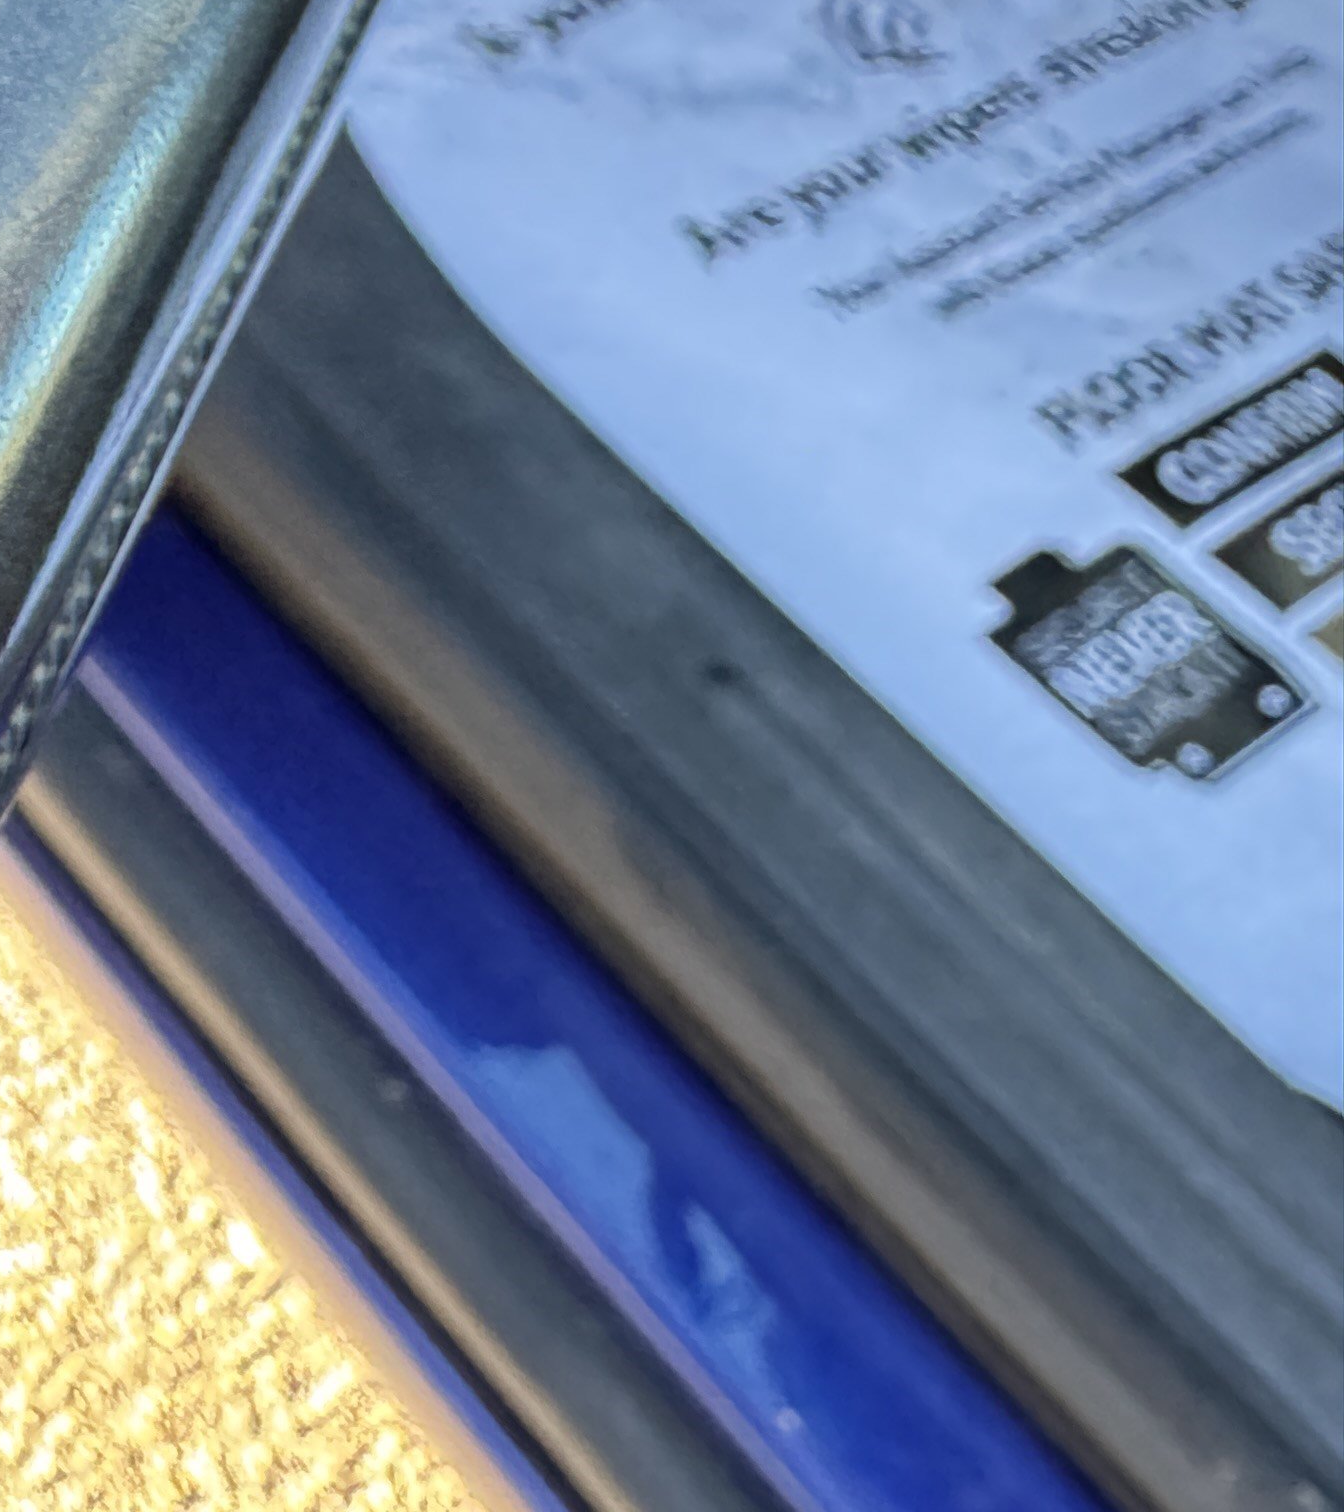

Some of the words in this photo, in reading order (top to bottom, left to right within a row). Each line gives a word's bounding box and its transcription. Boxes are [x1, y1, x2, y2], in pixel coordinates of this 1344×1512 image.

[675, 194, 784, 270] Are
[786, 143, 891, 232] your
[896, 68, 1044, 164] wipers
